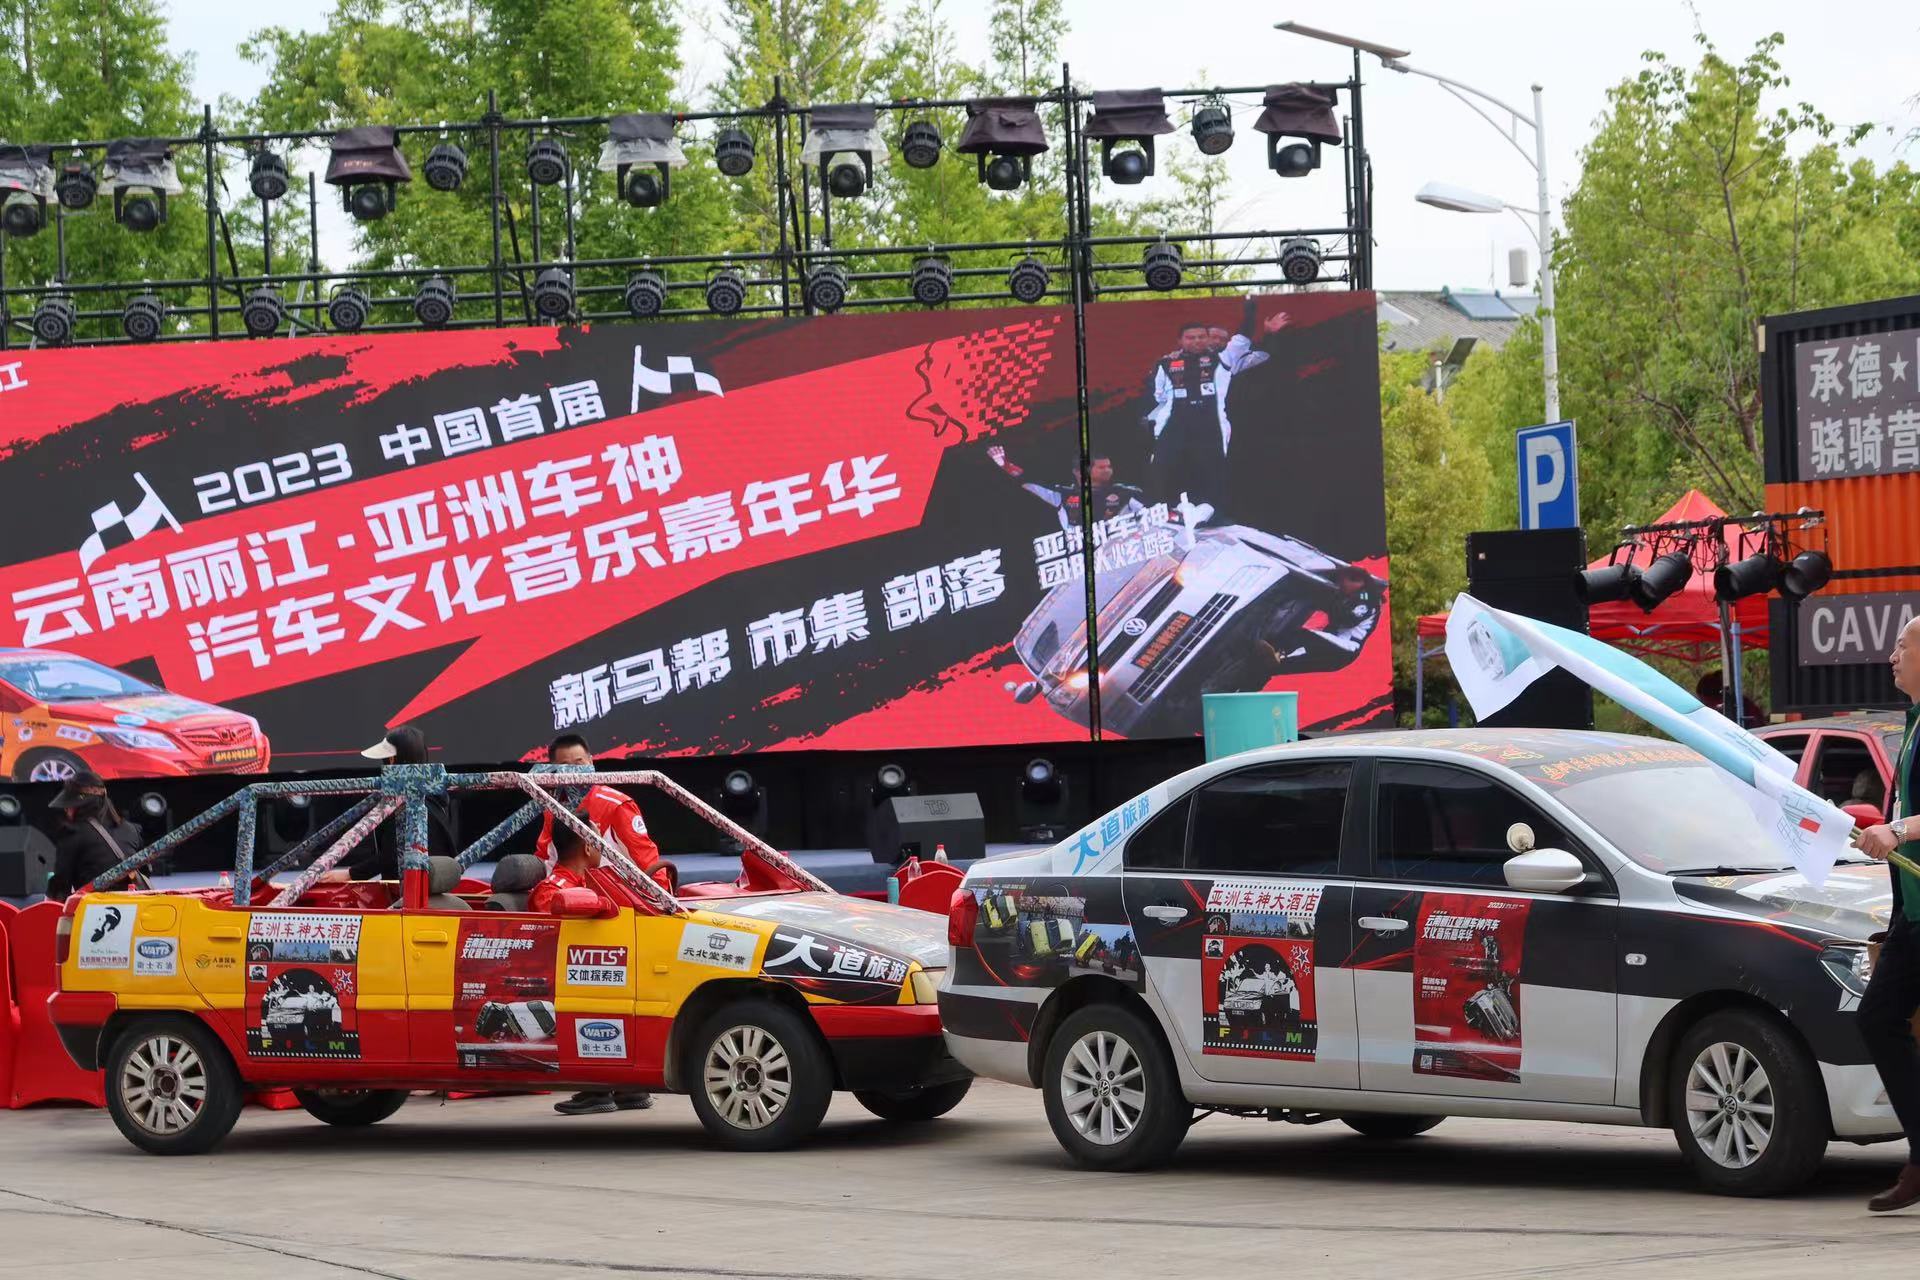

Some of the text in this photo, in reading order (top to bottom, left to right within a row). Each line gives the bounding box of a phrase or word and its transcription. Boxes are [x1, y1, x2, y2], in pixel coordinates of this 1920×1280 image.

[1810, 342, 1883, 402] 承德
[193, 379, 607, 514] 2023 中国首届
[1810, 409, 1920, 474] 骁骑营
[1526, 434, 1565, 530] P
[1033, 502, 1169, 563] 亚洲车神
[185, 453, 902, 682] 汽车文化音乐嘉年华
[549, 548, 1007, 730] 新马帮 市集 部落
[1069, 795, 1150, 876] 大道旅游
[1208, 889, 1320, 912] 亚洲车神大酒店
[140, 944, 170, 955] WATTS
[250, 922, 358, 940] 亚洲车神大酒店
[764, 933, 910, 983] 大道旅游
[568, 969, 624, 982] 文体探索家
[584, 1028, 617, 1038] WATTS
